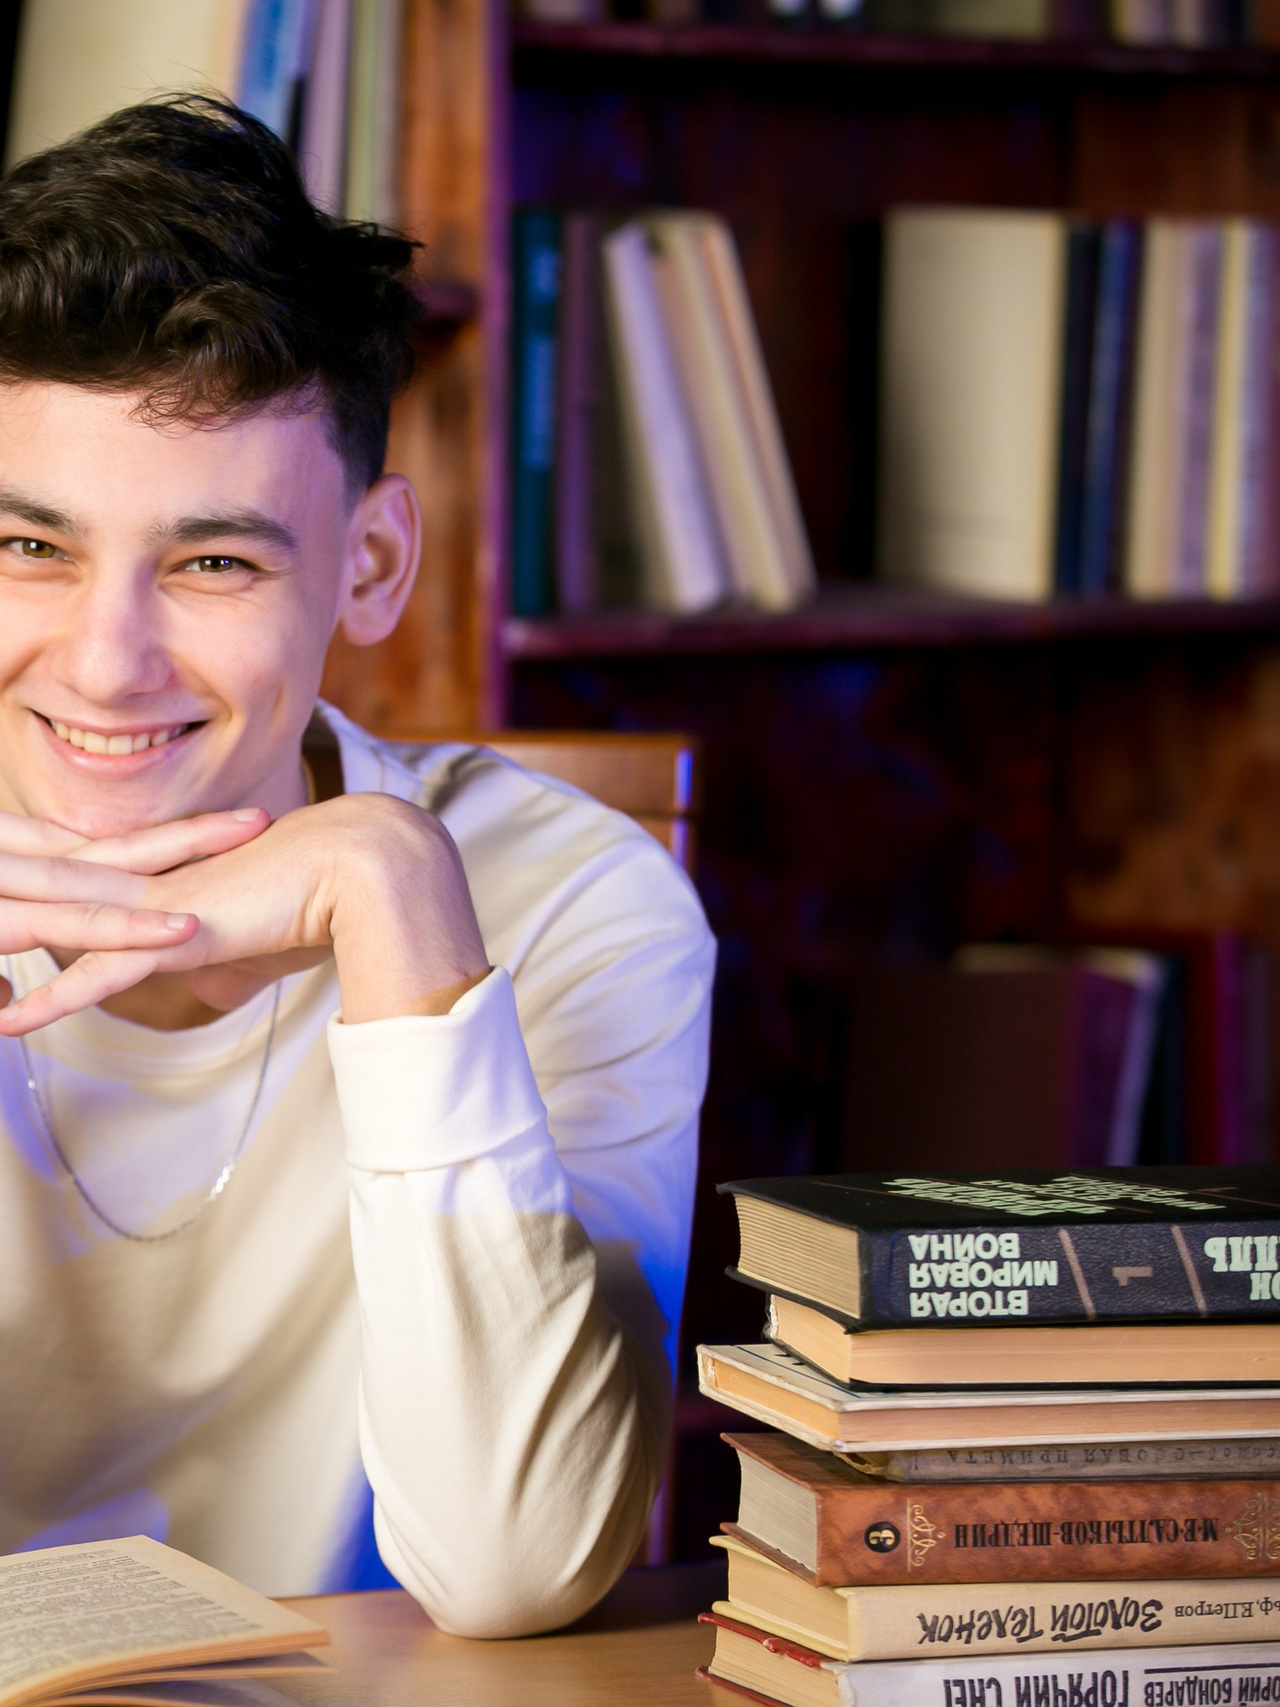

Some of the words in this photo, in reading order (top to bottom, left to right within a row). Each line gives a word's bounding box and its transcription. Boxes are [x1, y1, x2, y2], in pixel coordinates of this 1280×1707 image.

[908, 1232, 1020, 1264] ВОЙНА
[909, 1260, 1058, 1288] МИРОВАЯ
[1112, 1266, 1153, 1287] 1
[910, 1290, 1029, 1318] ВТОРАЯ
[946, 1449, 1069, 1464] ПРИМЕТА
[1144, 1675, 1232, 1707] БОНДАРЕВ
